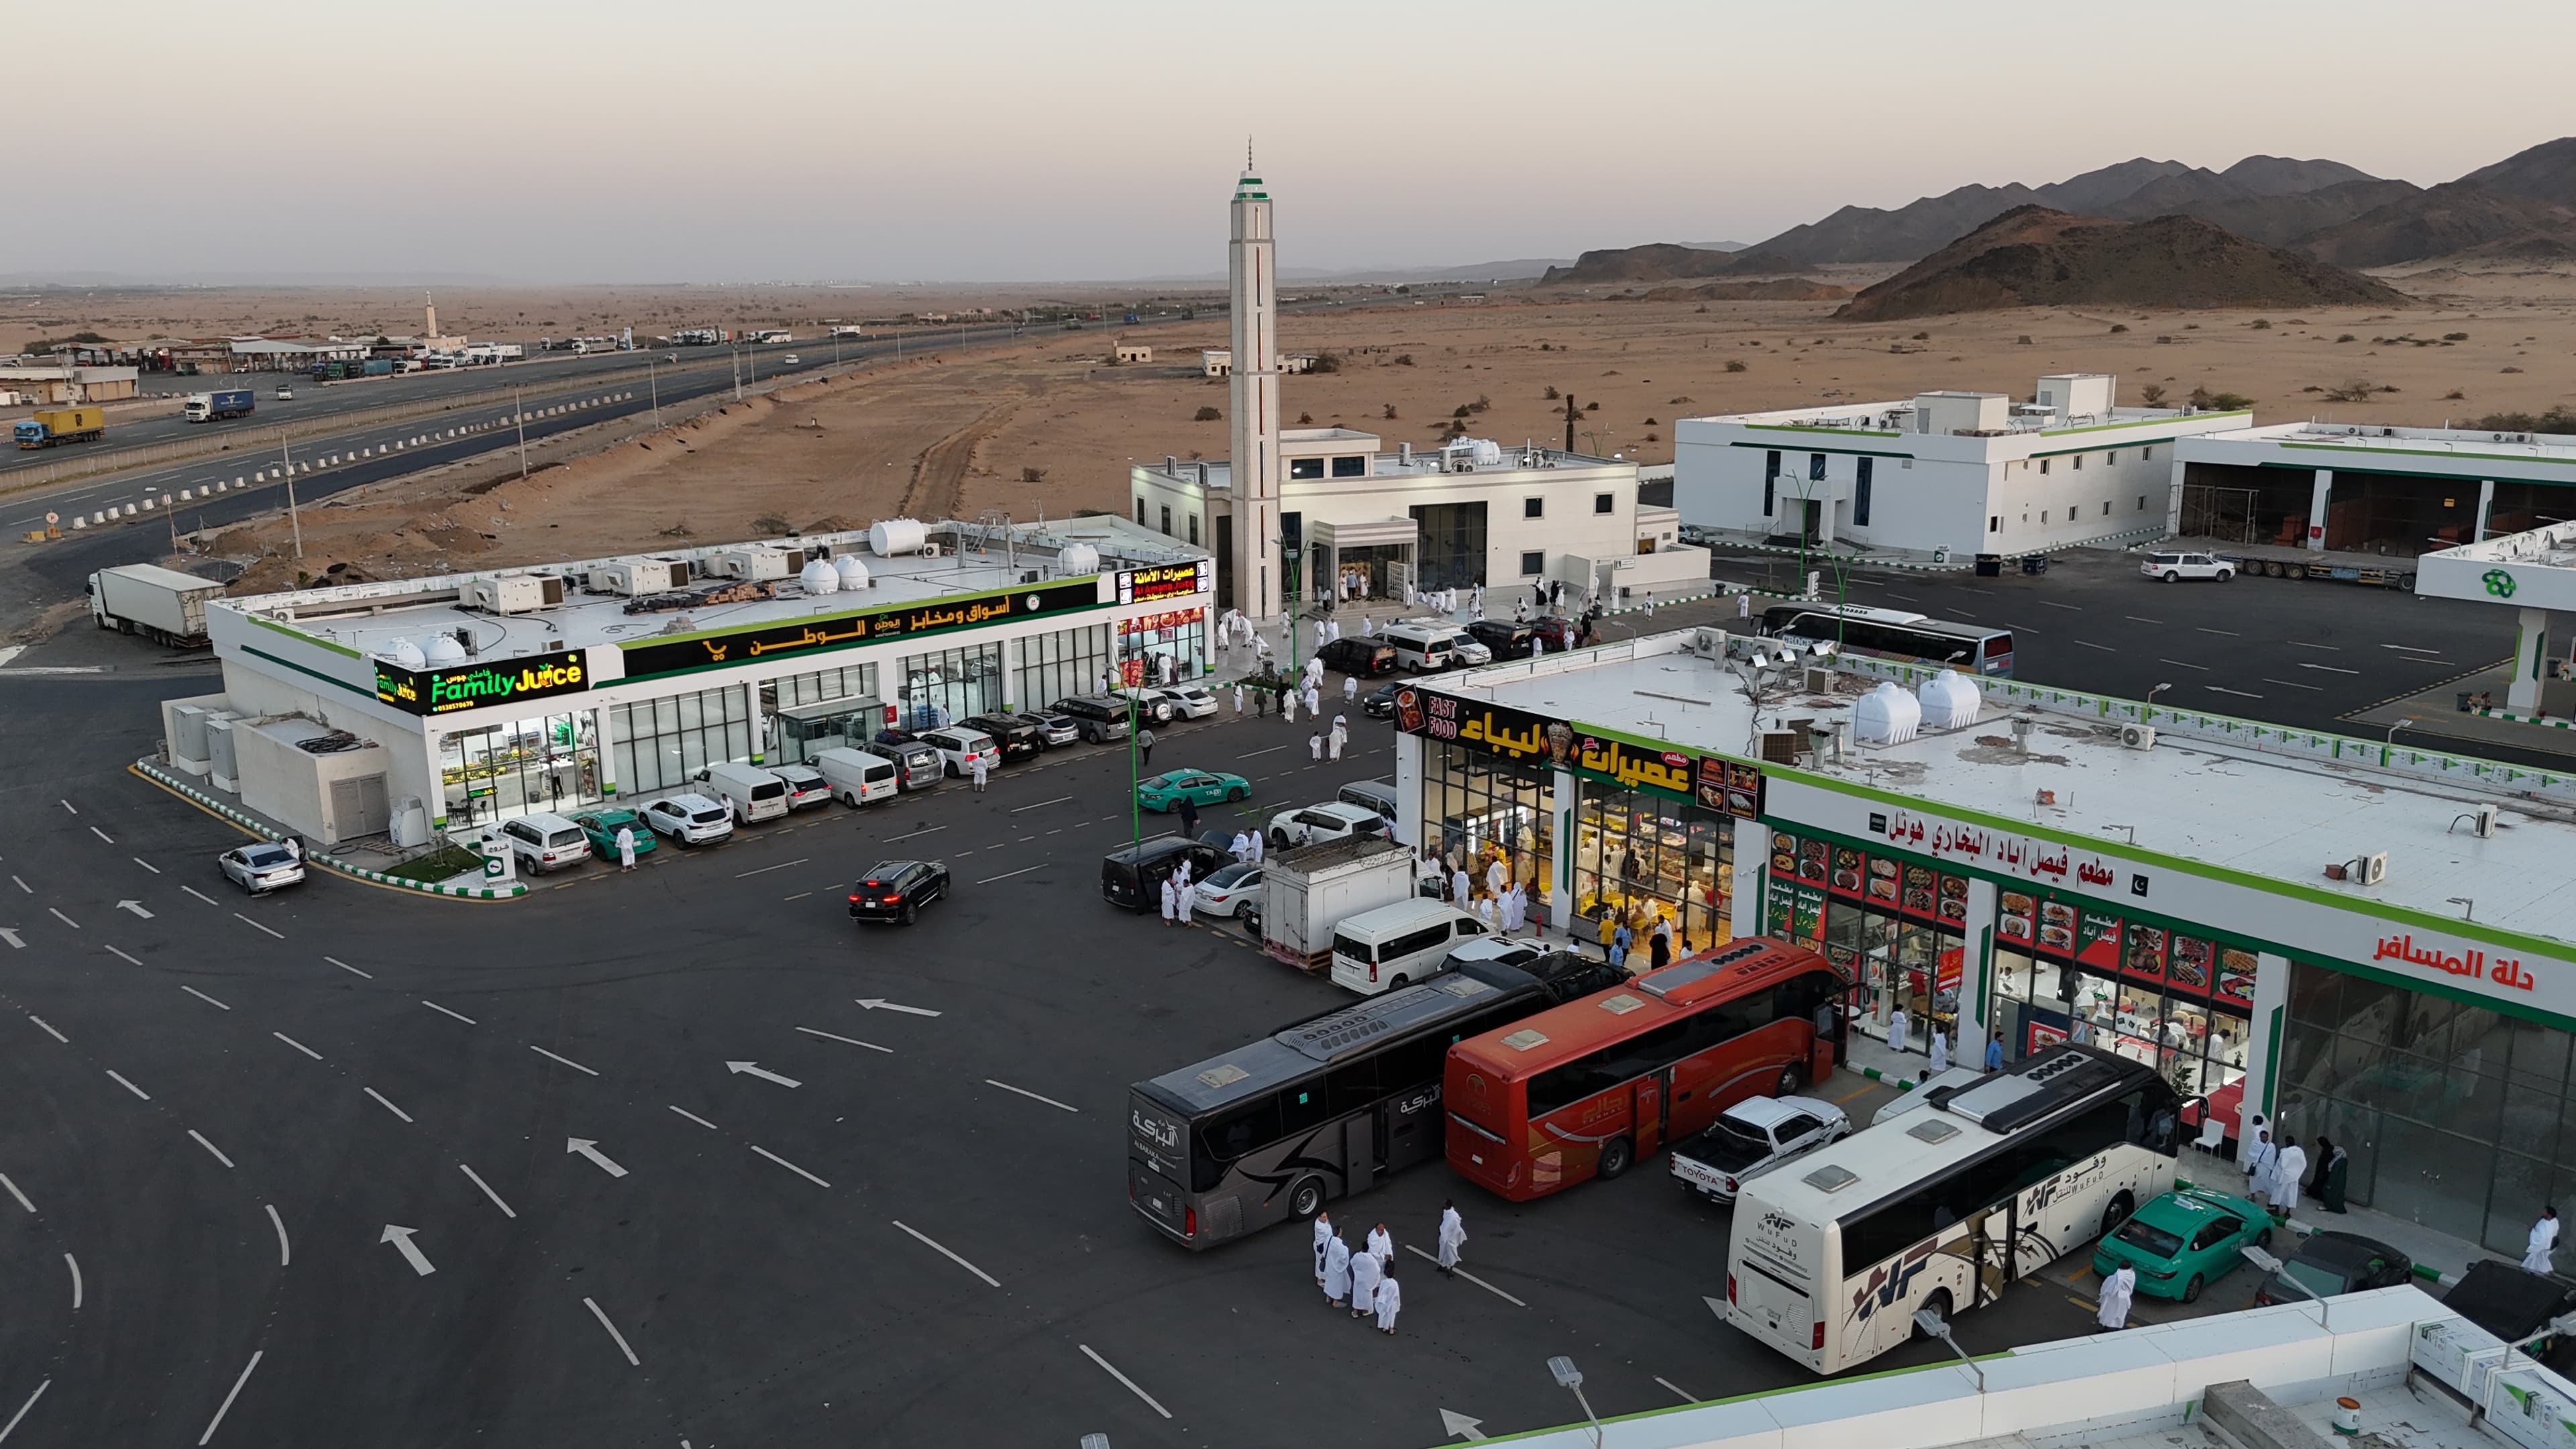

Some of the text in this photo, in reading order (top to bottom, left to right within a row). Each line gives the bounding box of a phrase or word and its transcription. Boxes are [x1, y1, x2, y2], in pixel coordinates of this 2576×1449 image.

[1163, 568, 1195, 582] عصيرات
[966, 595, 1010, 623] أسواق
[749, 619, 866, 655] الوطن
[431, 673, 516, 704] Family
[1428, 696, 1457, 719] FAST
[1428, 716, 1457, 739] FOOD
[1581, 738, 1690, 792] عصيرات
[2030, 845, 2068, 883] فيصل
[2076, 856, 2114, 888] مطعم
[2373, 934, 2534, 991] دلة المسافر
[1133, 1110, 1179, 1147] البركة
[1682, 1166, 1717, 1185] TOYOTA
[2065, 1155, 2106, 1184] وفود
